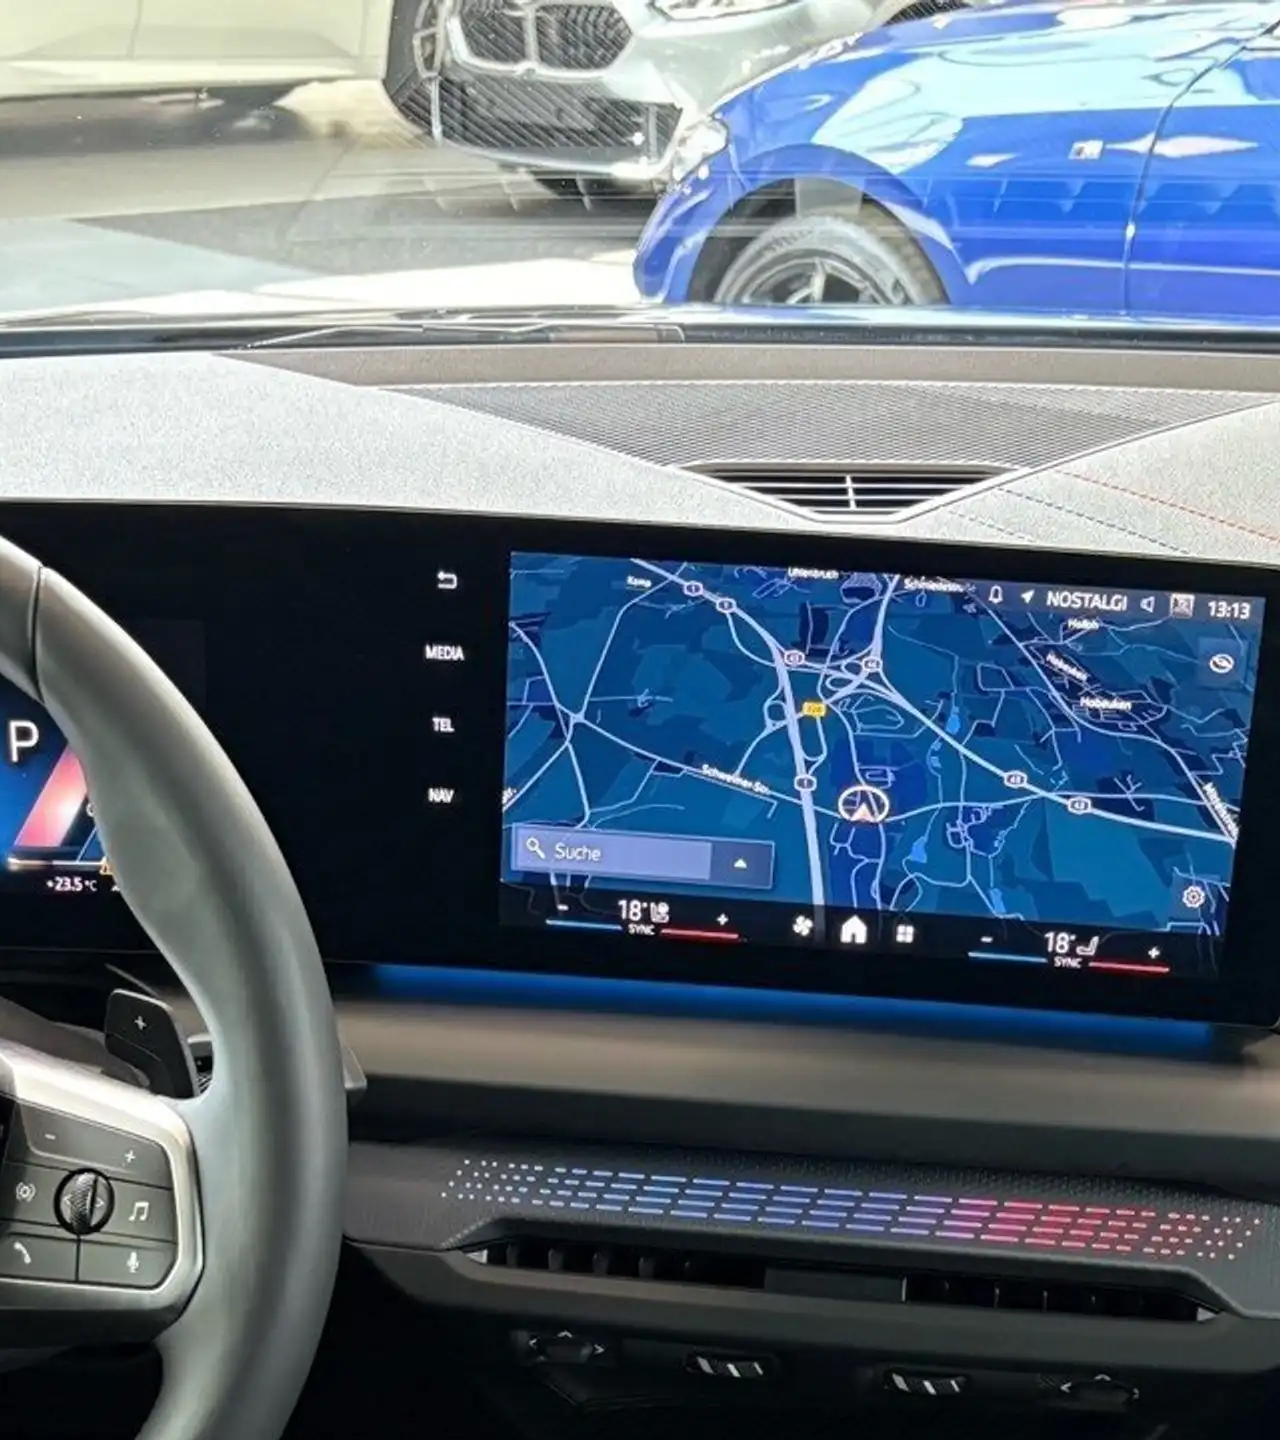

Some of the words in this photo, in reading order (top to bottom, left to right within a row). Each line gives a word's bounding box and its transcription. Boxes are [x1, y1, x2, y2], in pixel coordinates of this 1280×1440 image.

[1047, 591, 1128, 611] NOSTALGI
[1207, 600, 1251, 619] 13:13
[425, 645, 465, 661] MEDIA
[432, 717, 455, 732] TEL
[9, 720, 40, 763] P
[428, 788, 454, 803] NAV
[554, 844, 601, 862] Suche
[628, 925, 655, 936] SYNC
[1054, 957, 1082, 968] SYNC
